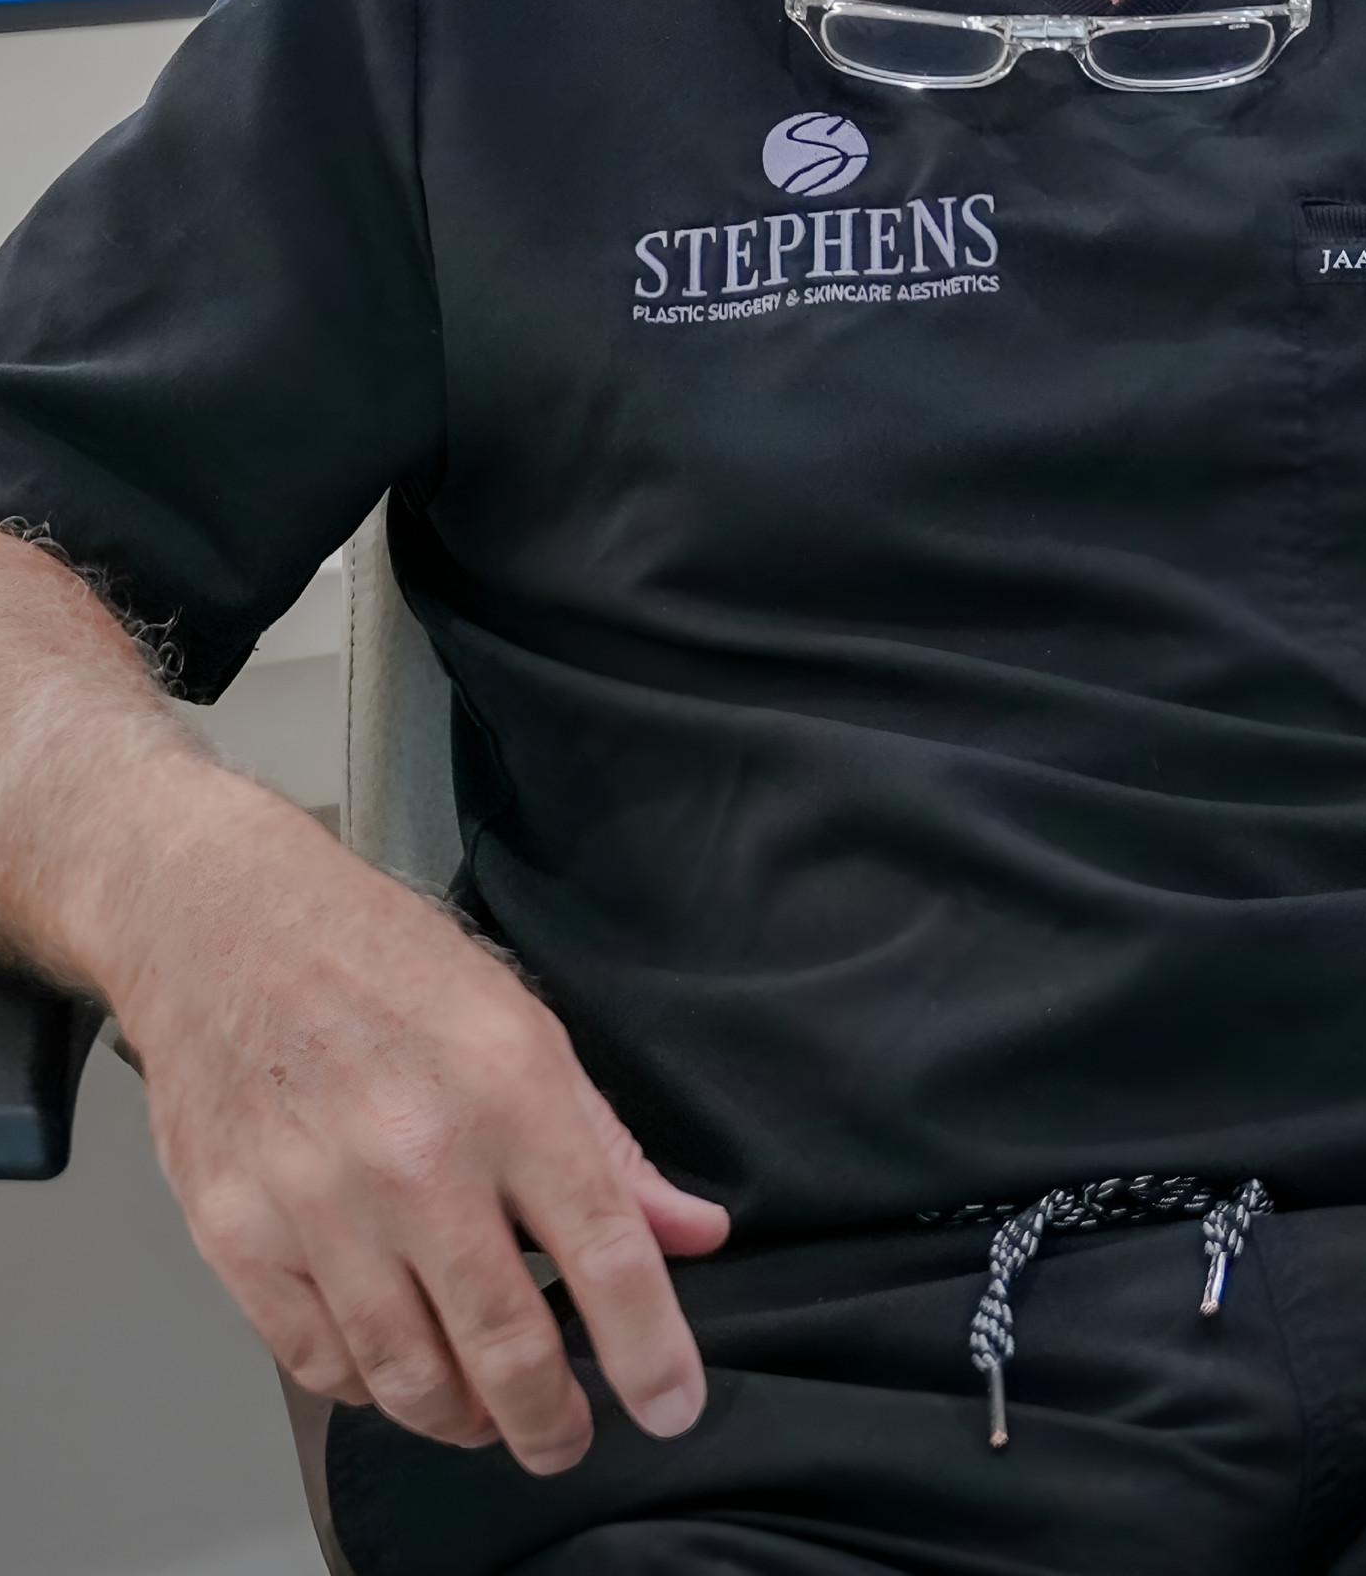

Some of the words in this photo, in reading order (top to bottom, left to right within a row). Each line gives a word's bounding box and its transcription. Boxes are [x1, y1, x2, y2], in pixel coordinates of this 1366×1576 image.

[634, 193, 999, 298] STEPHENS
[633, 304, 705, 324] PLASTIC
[707, 291, 782, 322] SURGERY
[785, 288, 800, 307] &
[804, 283, 892, 305] SKINCARE
[897, 274, 1001, 301] AESTHETICS
